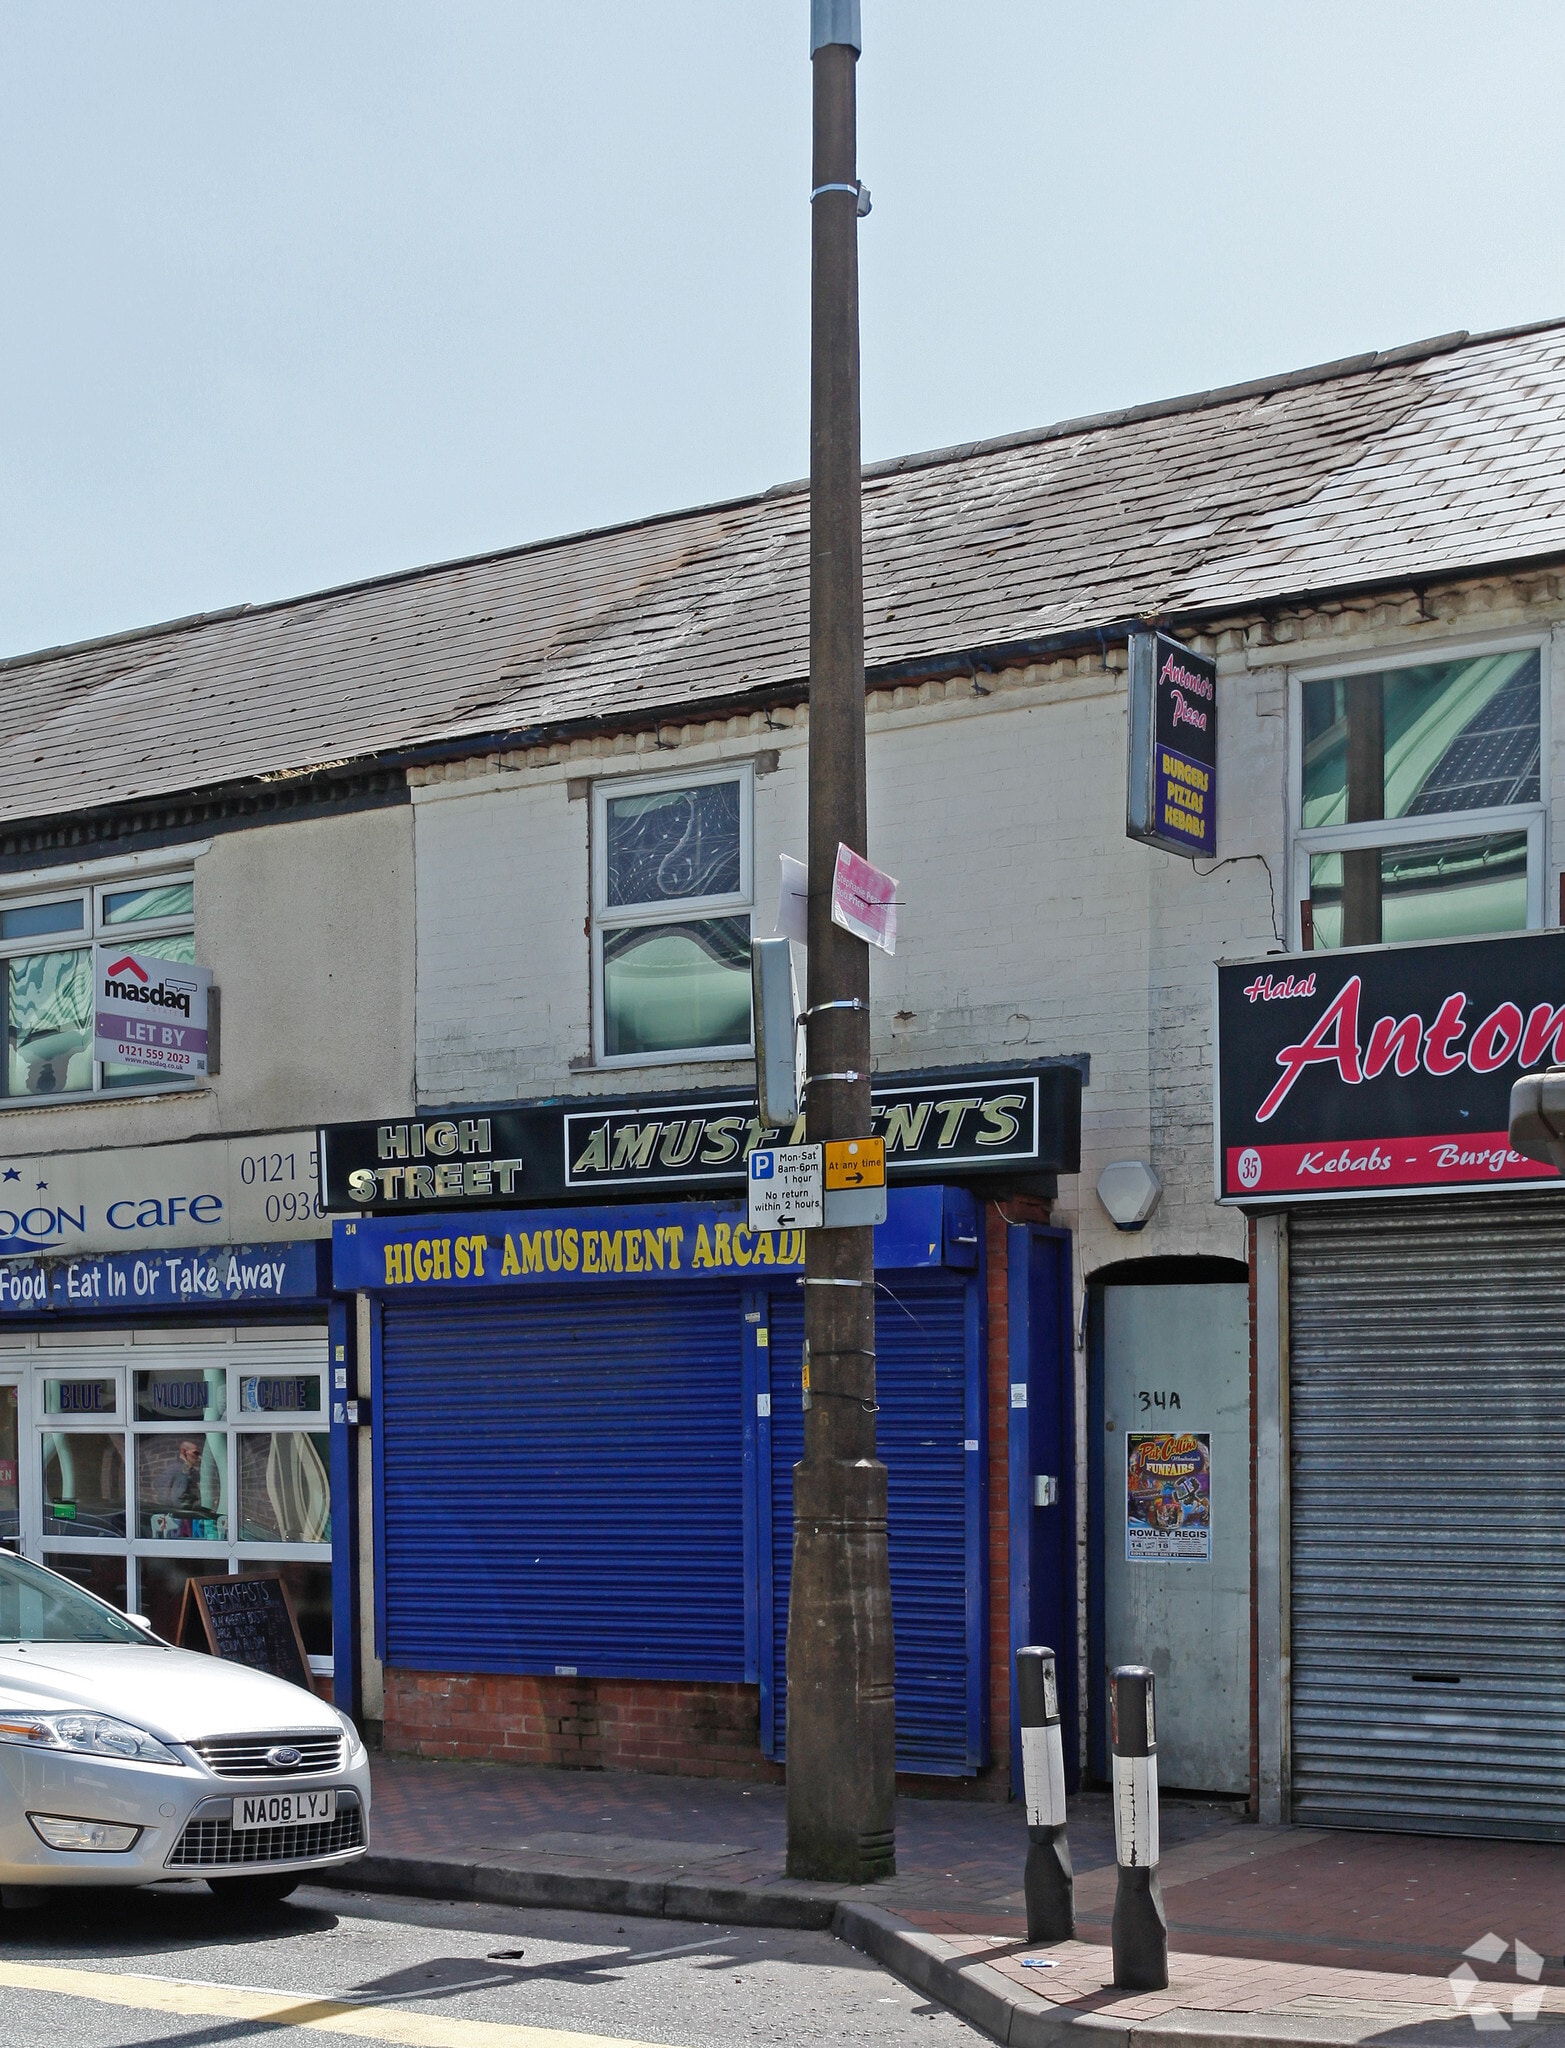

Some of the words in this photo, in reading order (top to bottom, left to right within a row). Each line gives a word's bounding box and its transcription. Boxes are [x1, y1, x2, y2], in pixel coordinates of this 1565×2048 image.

[1159, 653, 1213, 701] Antonio's
[1170, 689, 1207, 731] Pizza
[1162, 753, 1209, 793] BURGERS
[1167, 780, 1204, 815] PIZZAS
[1164, 803, 1205, 839] KEBABS
[105, 979, 190, 1018] masdaq
[1243, 972, 1317, 1003] Halal
[126, 1021, 157, 1042] LET
[162, 1027, 186, 1047] BY
[118, 1044, 142, 1057] 0121
[146, 1049, 163, 1060] 559
[167, 1052, 190, 1064] 2023
[125, 1056, 183, 1070] www.masdaq.co.uk
[377, 1118, 491, 1159] HIGH
[241, 1153, 294, 1185] 0121
[777, 1163, 819, 1174] 8am-6pm
[779, 1152, 817, 1162] Mon-Sat
[828, 1161, 838, 1171] At
[842, 1161, 858, 1172] any
[862, 1159, 881, 1168] time
[1242, 1157, 1258, 1179] 35
[1296, 1147, 1392, 1176] Kebabs
[1429, 1143, 1529, 1172] Burge
[347, 1158, 522, 1202] STREET
[792, 1175, 812, 1183] hour
[755, 1202, 781, 1212] within
[785, 1202, 791, 1210] 2
[795, 1200, 820, 1209] hours
[765, 1191, 778, 1200] No
[781, 1190, 809, 1199] return
[345, 1223, 357, 1236] 34
[500, 1224, 684, 1276] AMUSEMENT
[691, 1221, 805, 1268] ARCAD
[0, 1269, 46, 1301] Food
[67, 1264, 102, 1299] Eat
[107, 1263, 127, 1297] In
[133, 1260, 160, 1296] Or
[165, 1258, 220, 1294] Take
[225, 1255, 286, 1294] Away
[60, 1383, 102, 1409] BLUE
[153, 1381, 209, 1408] MOON
[257, 1380, 306, 1408] CAFE
[1138, 1391, 1181, 1412] 34A
[1138, 1442, 1160, 1467] Pat
[1161, 1437, 1198, 1461] Collins
[1146, 1463, 1195, 1476] FUNFAIRS
[203, 1581, 270, 1605] BREAKFASTS
[243, 1799, 291, 1823] NA08
[297, 1793, 329, 1819] LYJ
